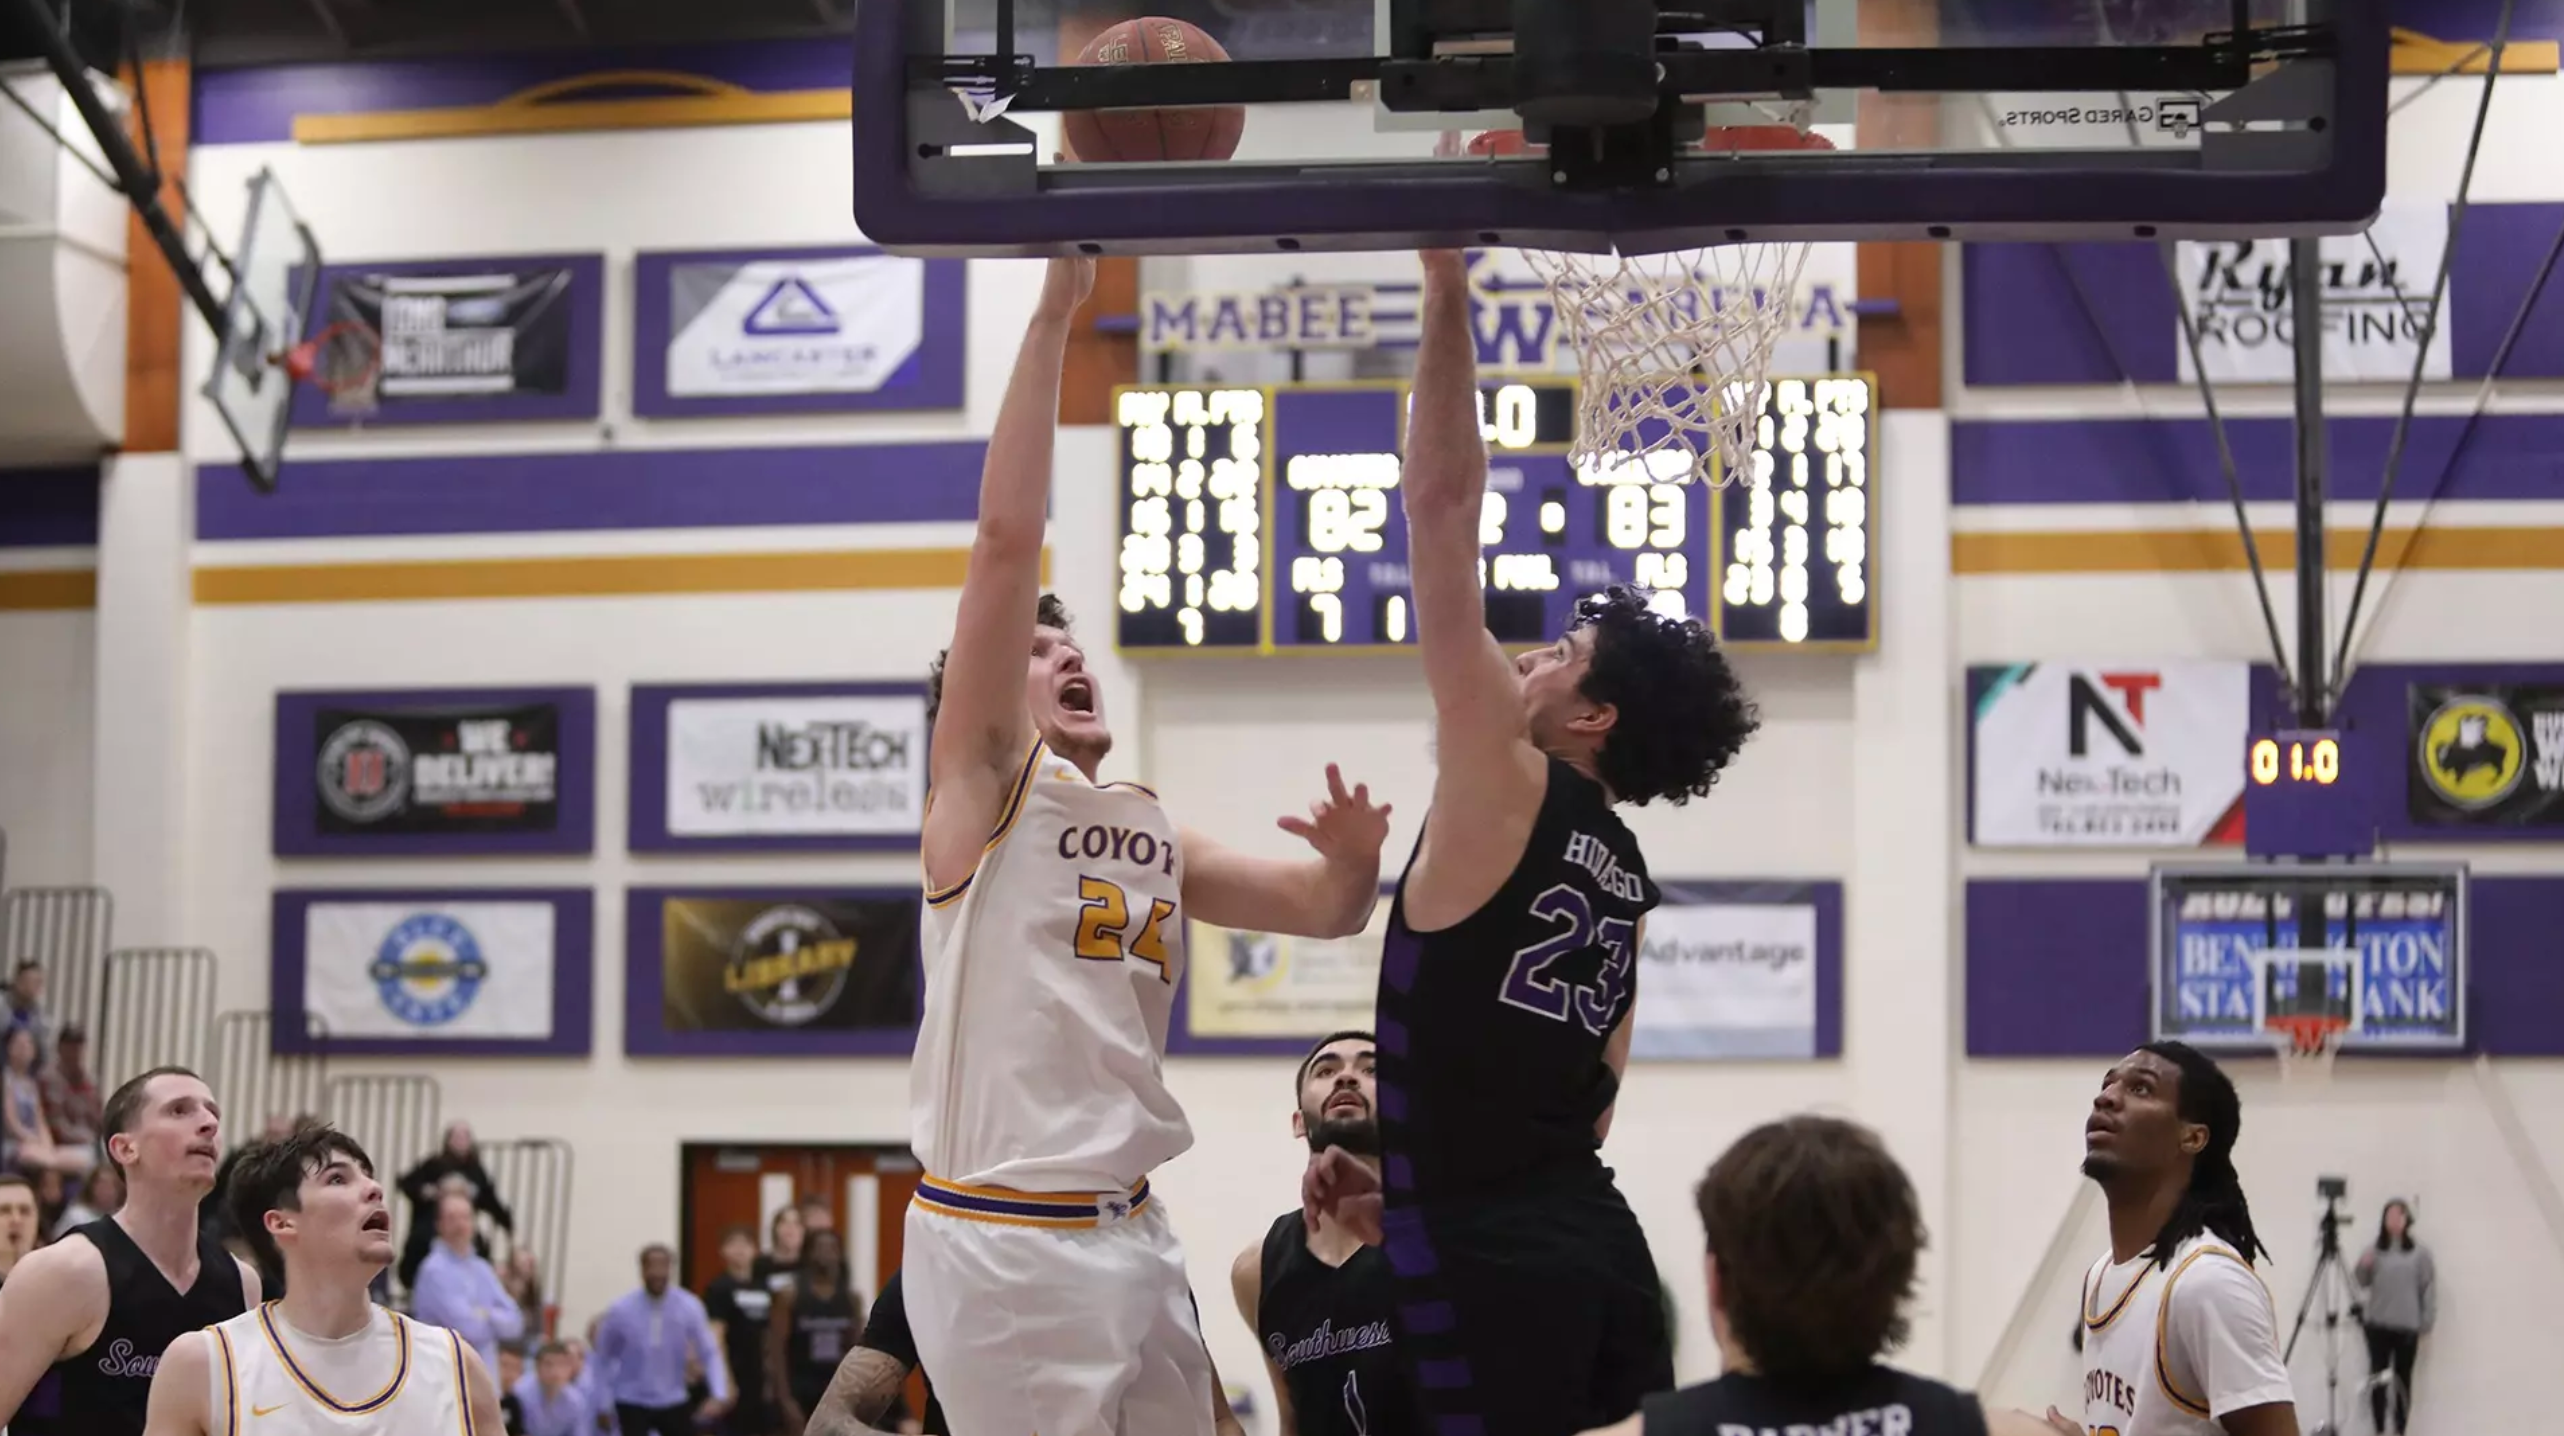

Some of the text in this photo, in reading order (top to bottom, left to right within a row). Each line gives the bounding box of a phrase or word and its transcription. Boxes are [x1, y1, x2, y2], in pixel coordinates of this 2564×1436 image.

[1149, 295, 1369, 342] MABEE
[1309, 488, 1387, 552] 82
[1607, 484, 1686, 549] 83
[457, 718, 511, 753] WE
[1075, 874, 1176, 985] 24
[1499, 883, 1634, 1036] 23
[2182, 932, 2444, 976] BENTON
